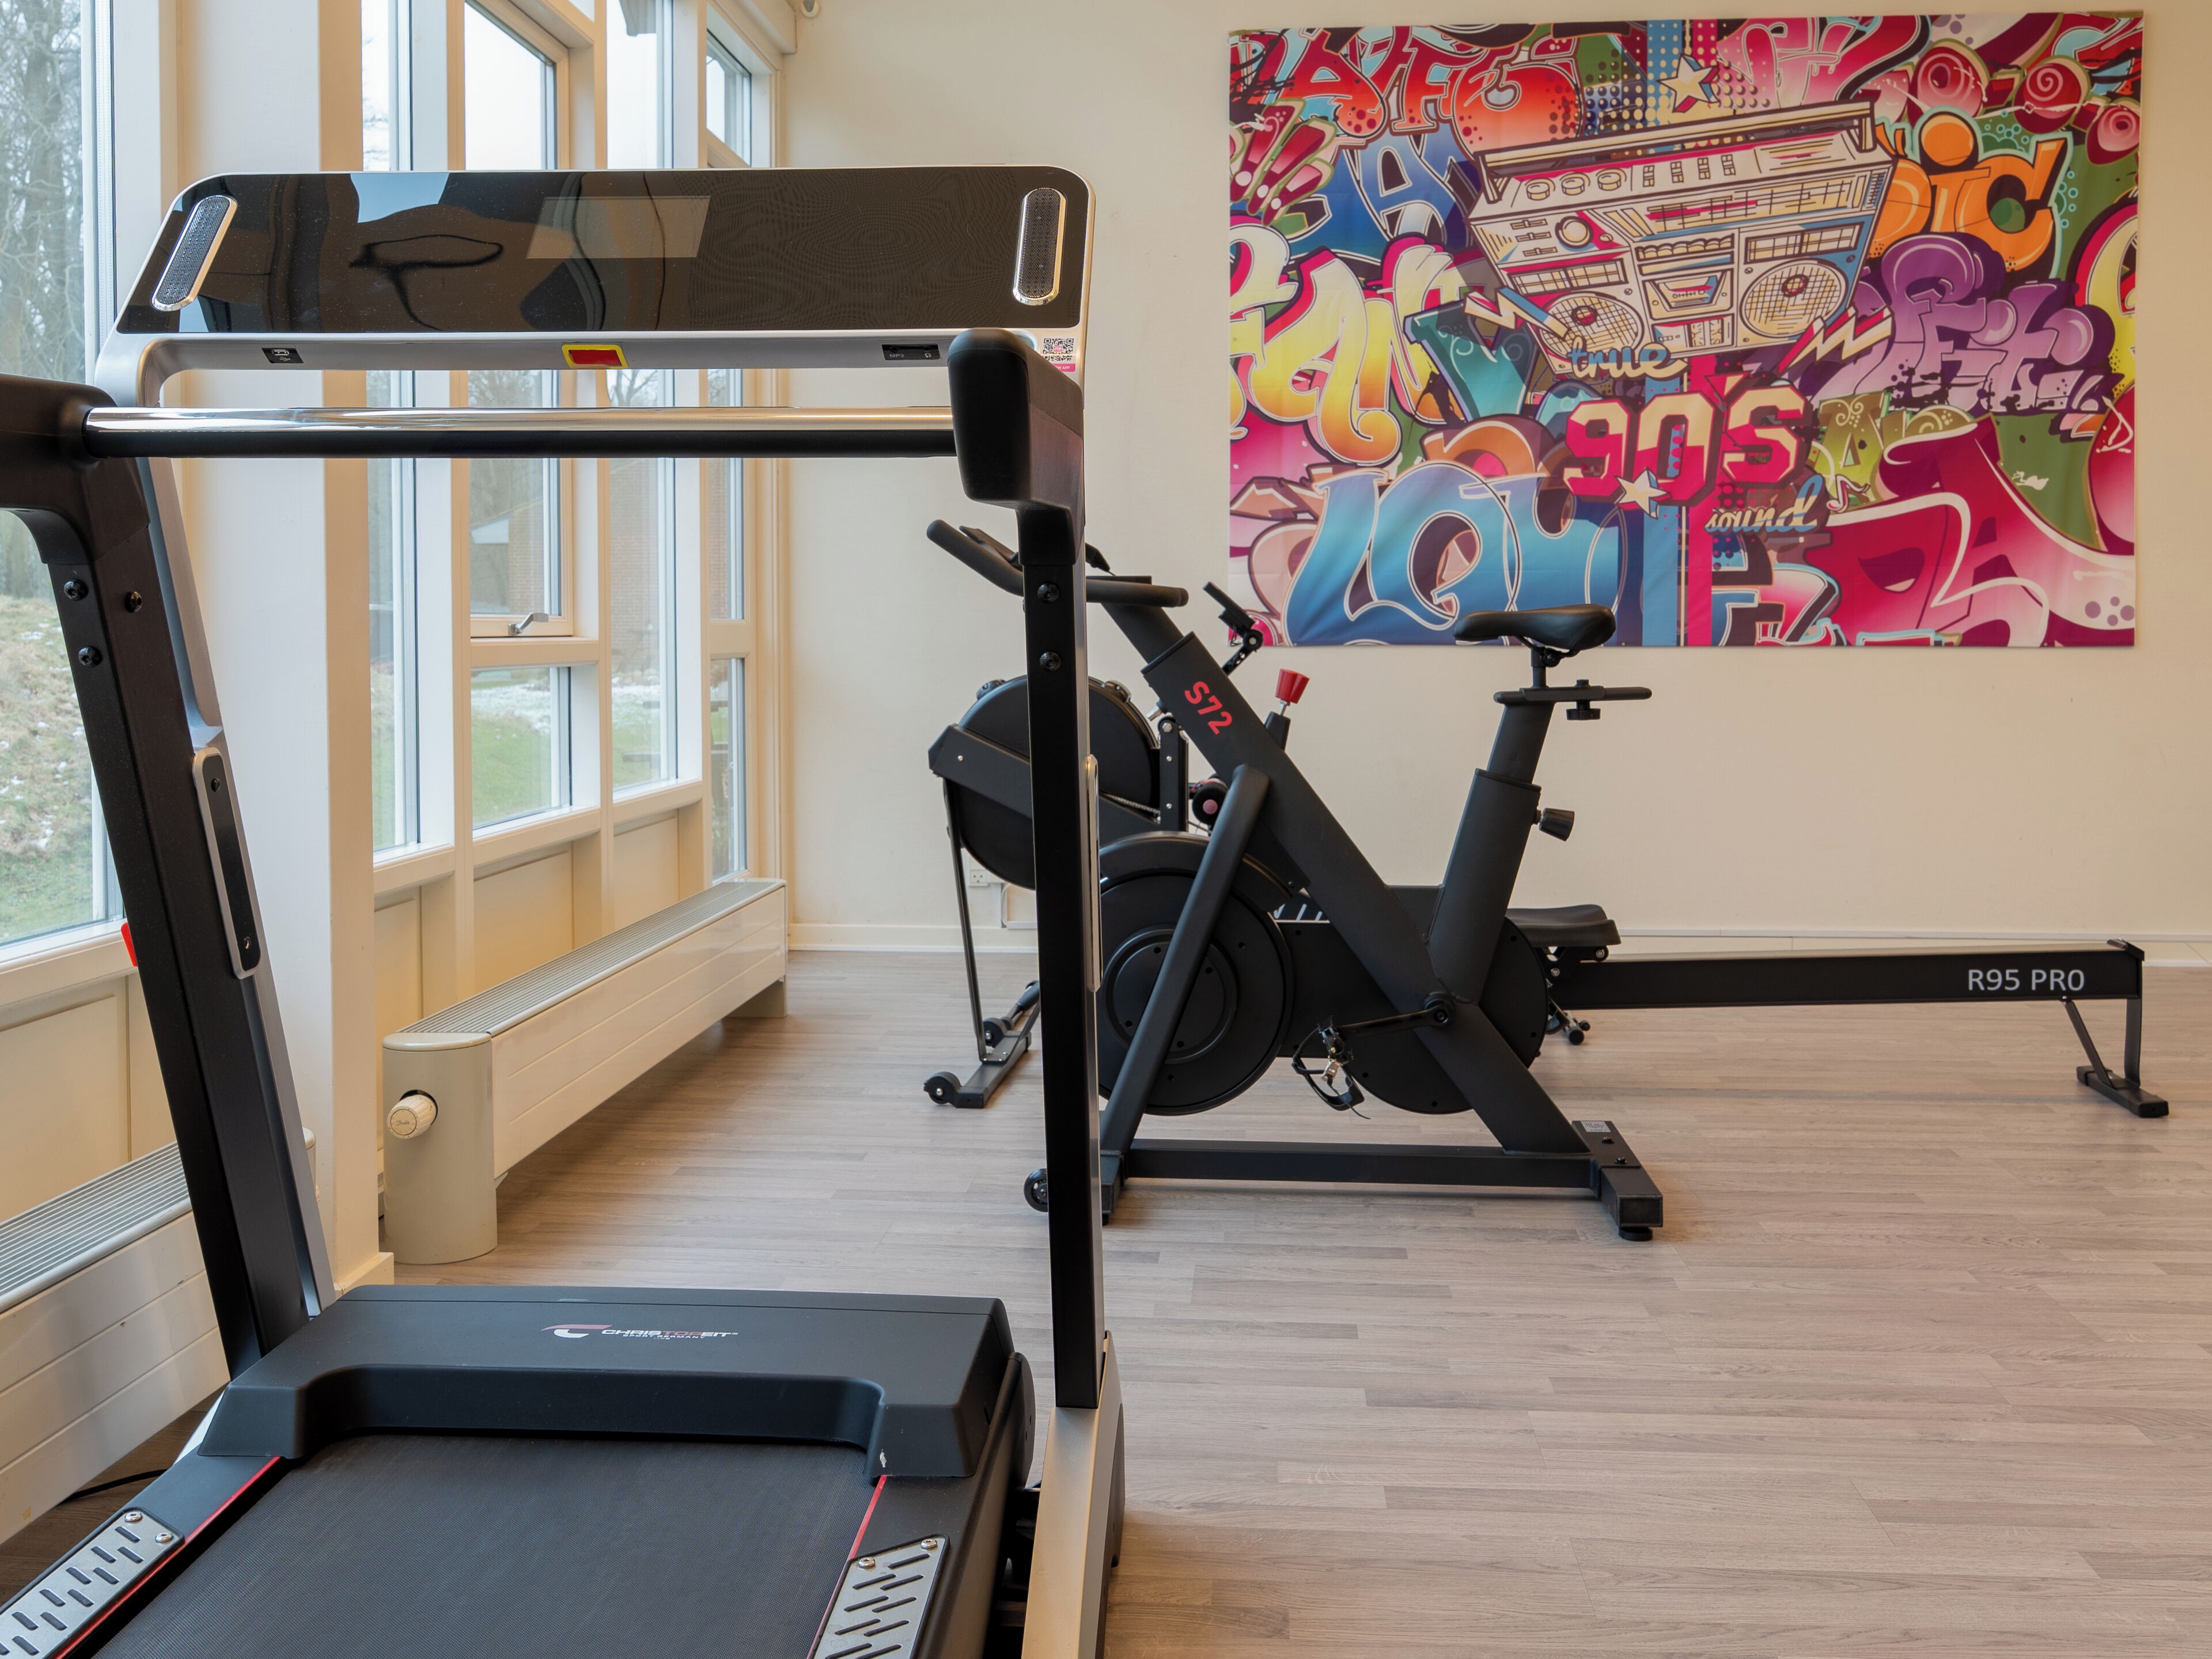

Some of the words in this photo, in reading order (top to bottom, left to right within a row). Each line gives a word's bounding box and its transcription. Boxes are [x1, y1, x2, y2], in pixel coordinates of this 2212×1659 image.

[1567, 335, 1690, 378] true
[1705, 474, 1820, 532] sound
[1184, 681, 1232, 735] S72
[1968, 969, 2020, 991] R95
[2031, 969, 2084, 991] PRO
